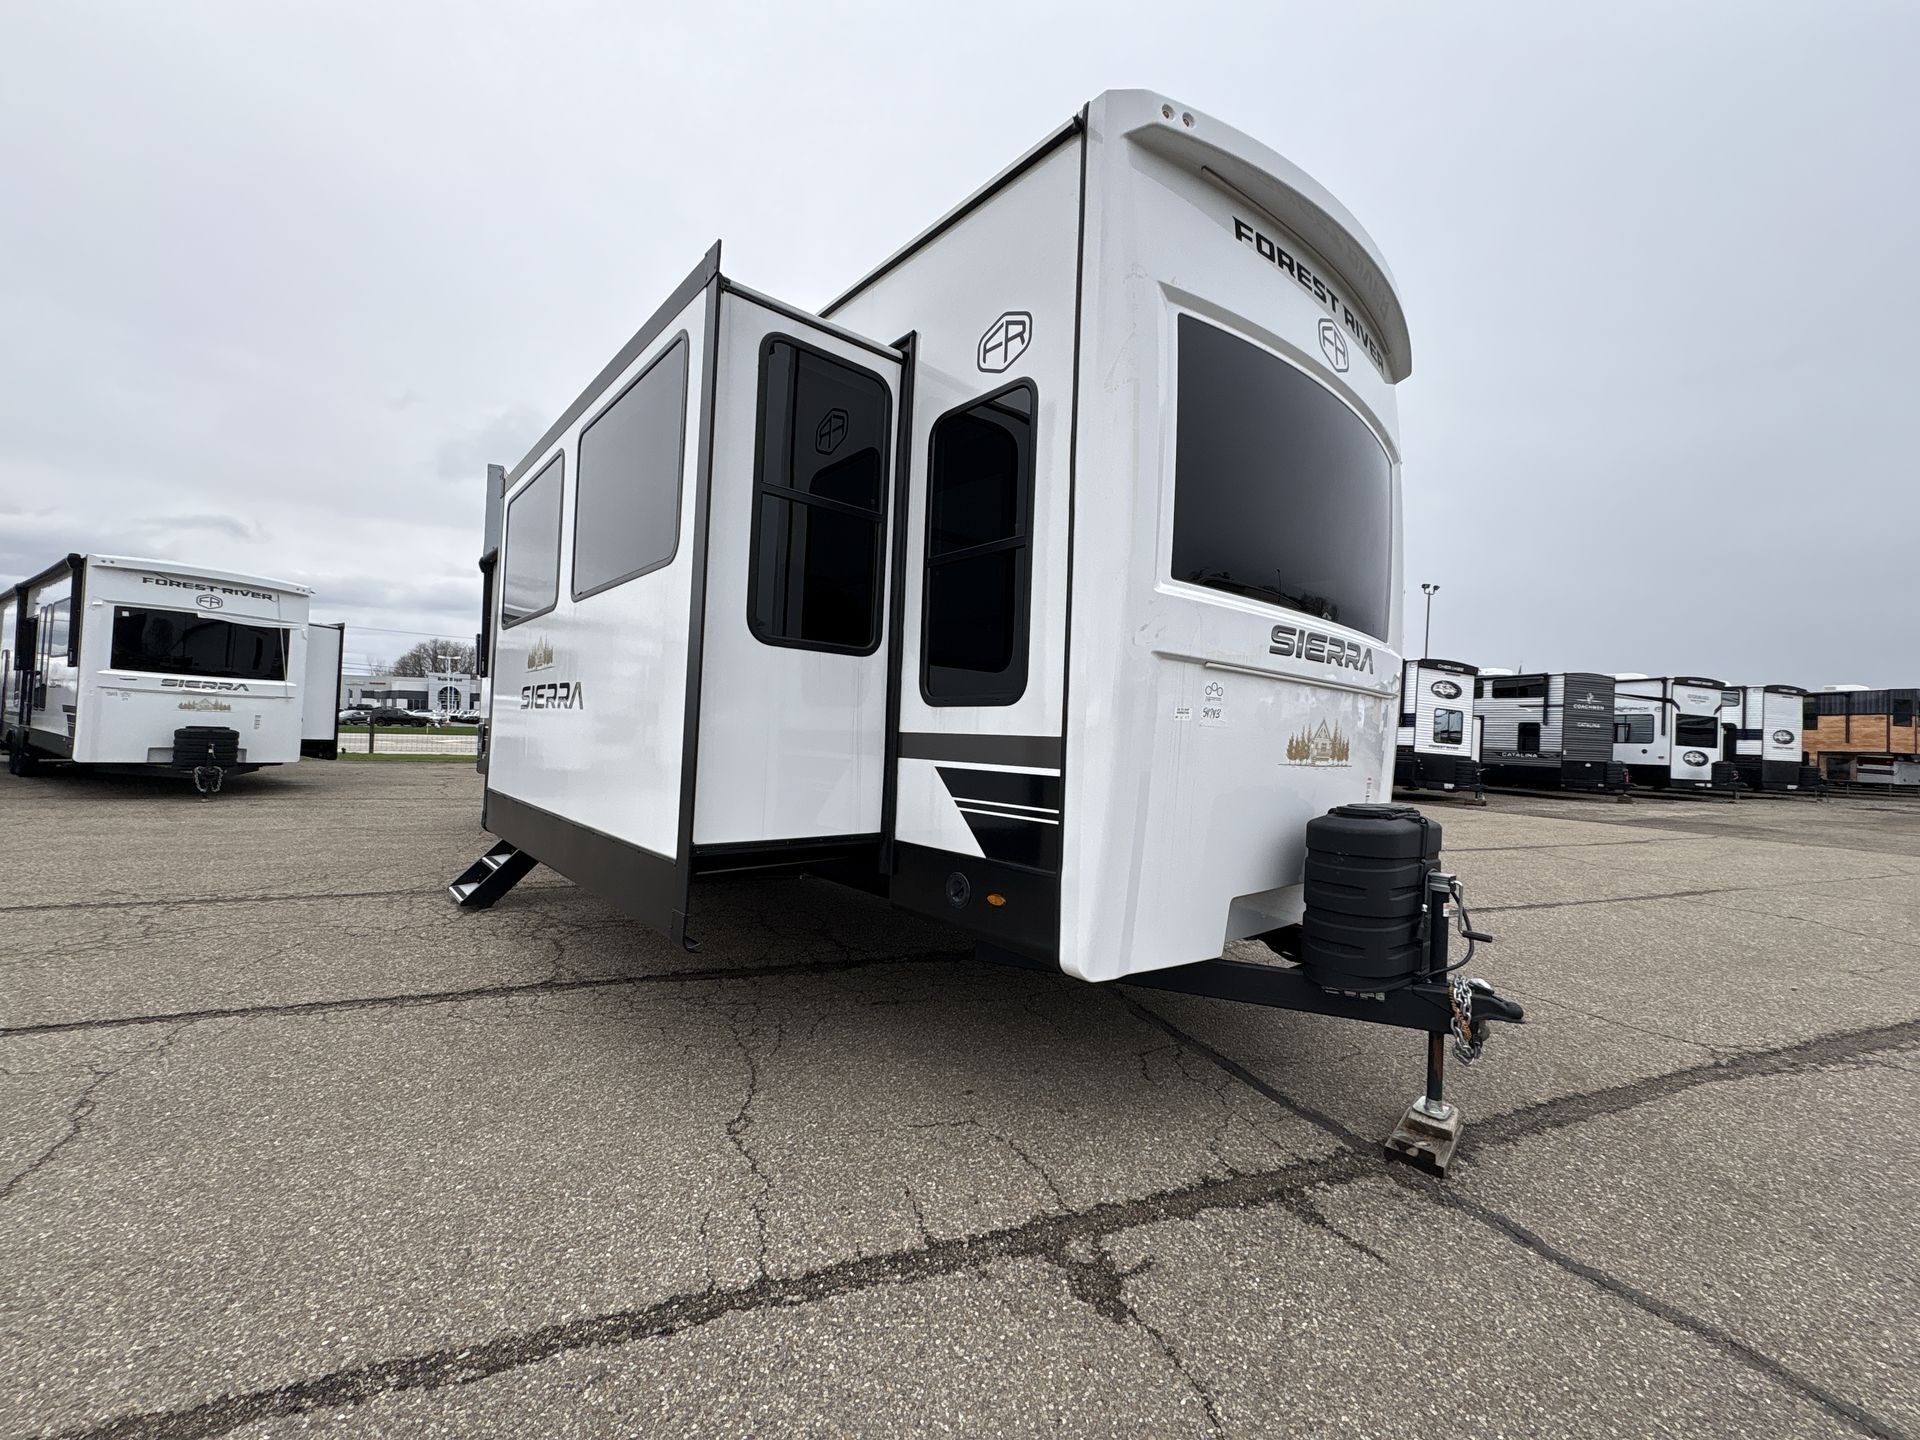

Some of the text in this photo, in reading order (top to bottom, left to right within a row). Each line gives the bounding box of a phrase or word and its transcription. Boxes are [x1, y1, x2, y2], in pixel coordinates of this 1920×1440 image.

[1232, 216, 1384, 374] FOREST RIVER
[142, 577, 273, 600] FOREST RIVER
[1269, 625, 1374, 675] SIERRA
[161, 678, 249, 691] SIERRA
[521, 681, 583, 710] SIERRA
